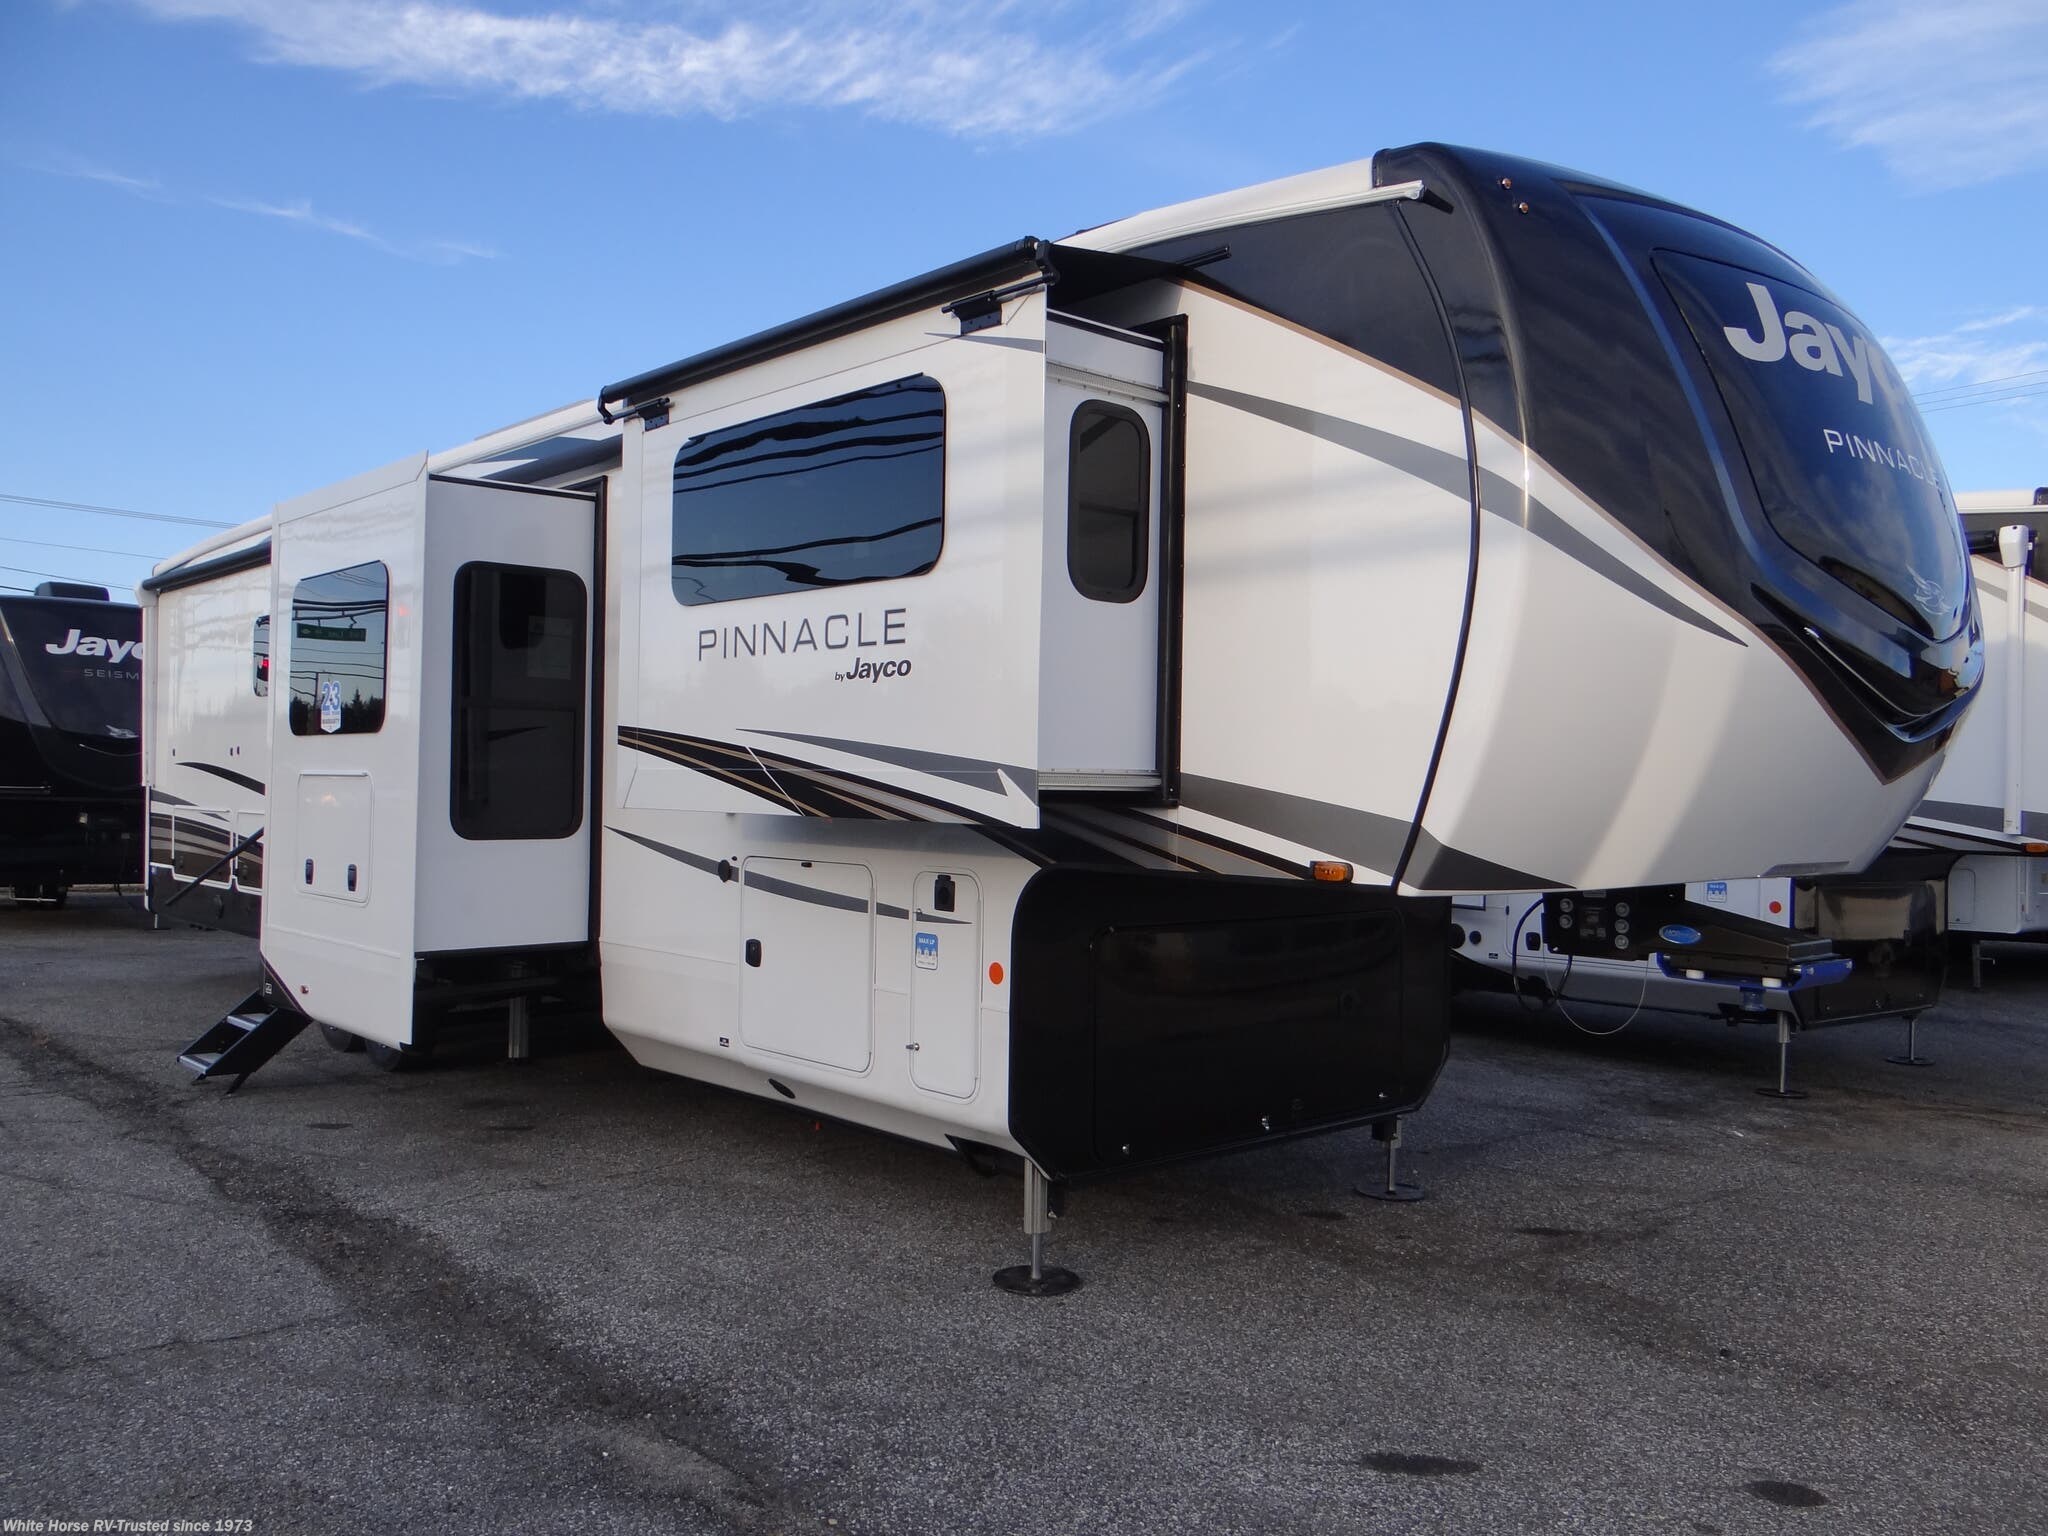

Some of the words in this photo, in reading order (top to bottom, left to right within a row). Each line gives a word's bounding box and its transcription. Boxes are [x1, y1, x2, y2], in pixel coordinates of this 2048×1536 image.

[698, 607, 907, 661] PINNACLE
[834, 671, 845, 682] by
[846, 657, 912, 683] Jayco
